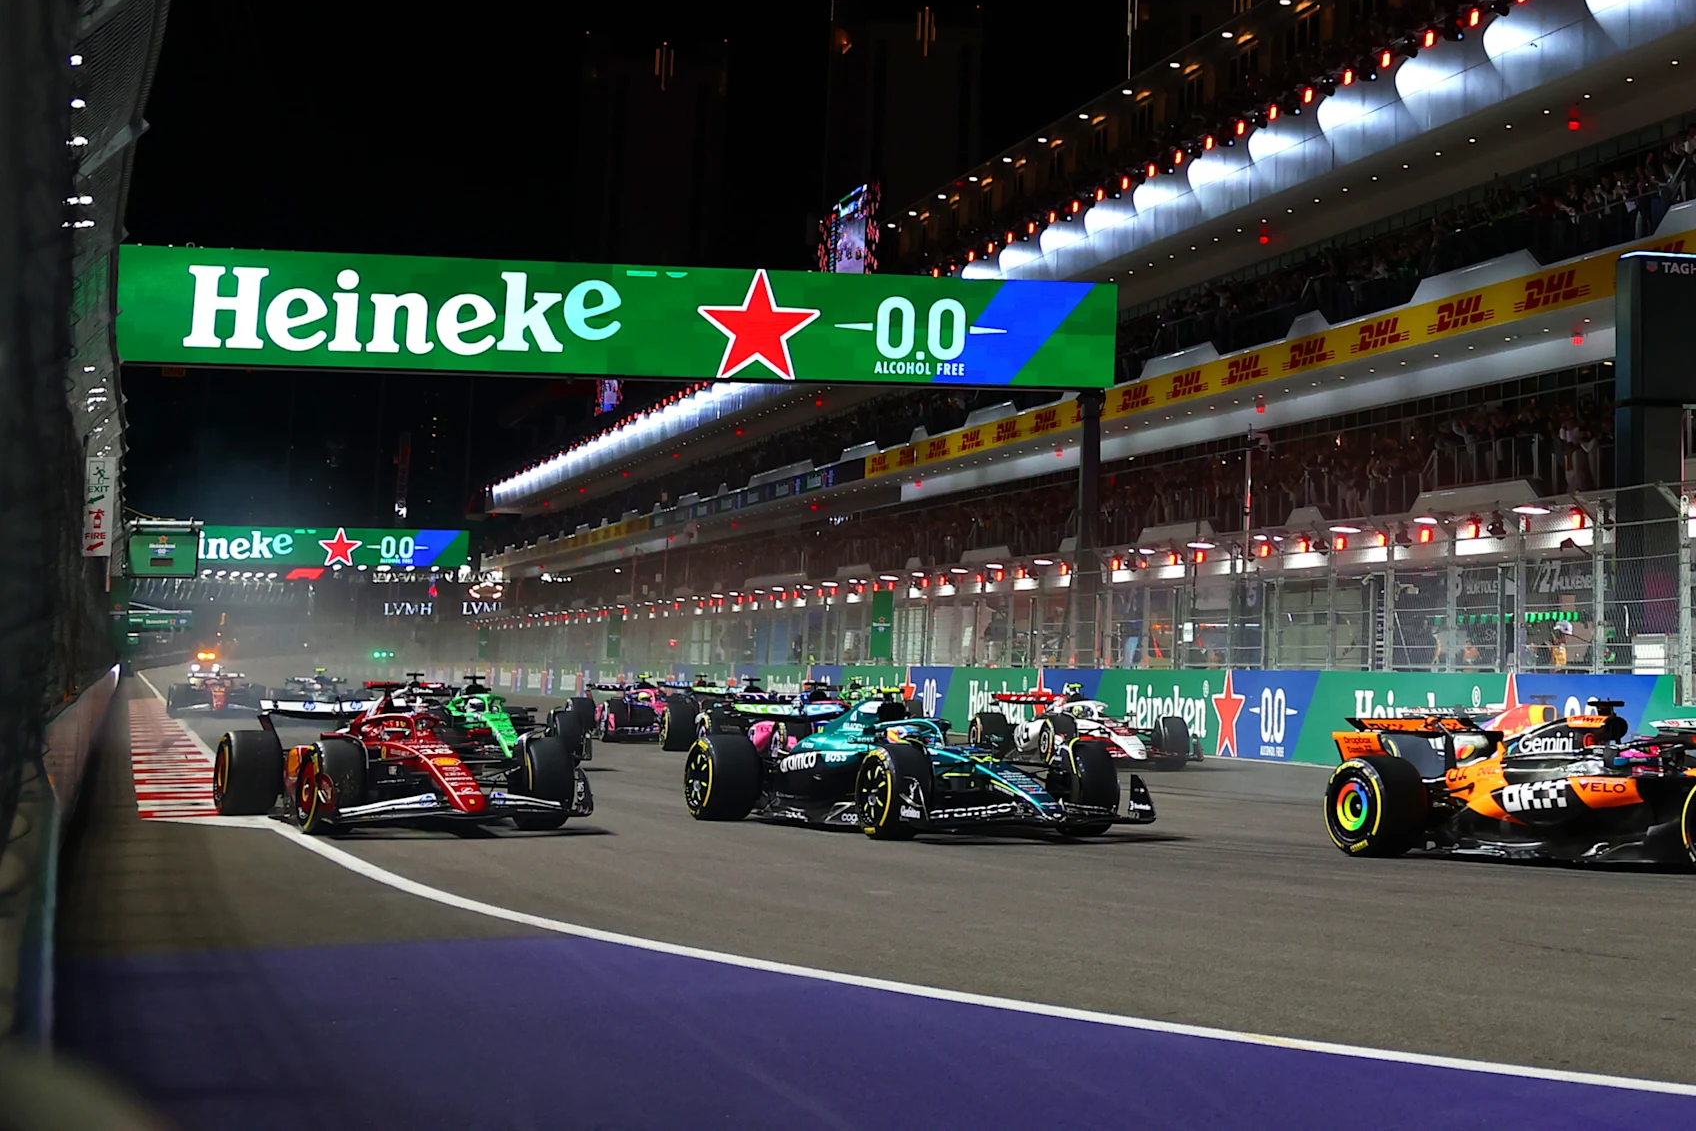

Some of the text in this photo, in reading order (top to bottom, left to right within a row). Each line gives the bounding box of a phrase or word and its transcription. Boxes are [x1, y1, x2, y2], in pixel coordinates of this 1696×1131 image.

[1524, 270, 1583, 309] DHL
[183, 265, 622, 356] Heineke
[1437, 295, 1487, 332] DHL
[876, 296, 966, 361] 0.0
[1359, 317, 1404, 351] DHL
[1290, 337, 1328, 368] DHL
[874, 361, 965, 376] ALCOHOL FREE
[1228, 354, 1262, 384] DHL
[1122, 385, 1150, 411] DHL
[1172, 370, 1203, 398] DHL
[380, 536, 415, 558] 0.0
[384, 602, 433, 615] LVMH
[1124, 684, 1206, 738] Heineken
[1260, 687, 1286, 744] 0.0
[1344, 736, 1371, 745] Dropbox
[1519, 732, 1574, 753] Gemini
[780, 751, 817, 772] aramco
[825, 752, 848, 763] BOSS
[1579, 779, 1626, 794] VELO
